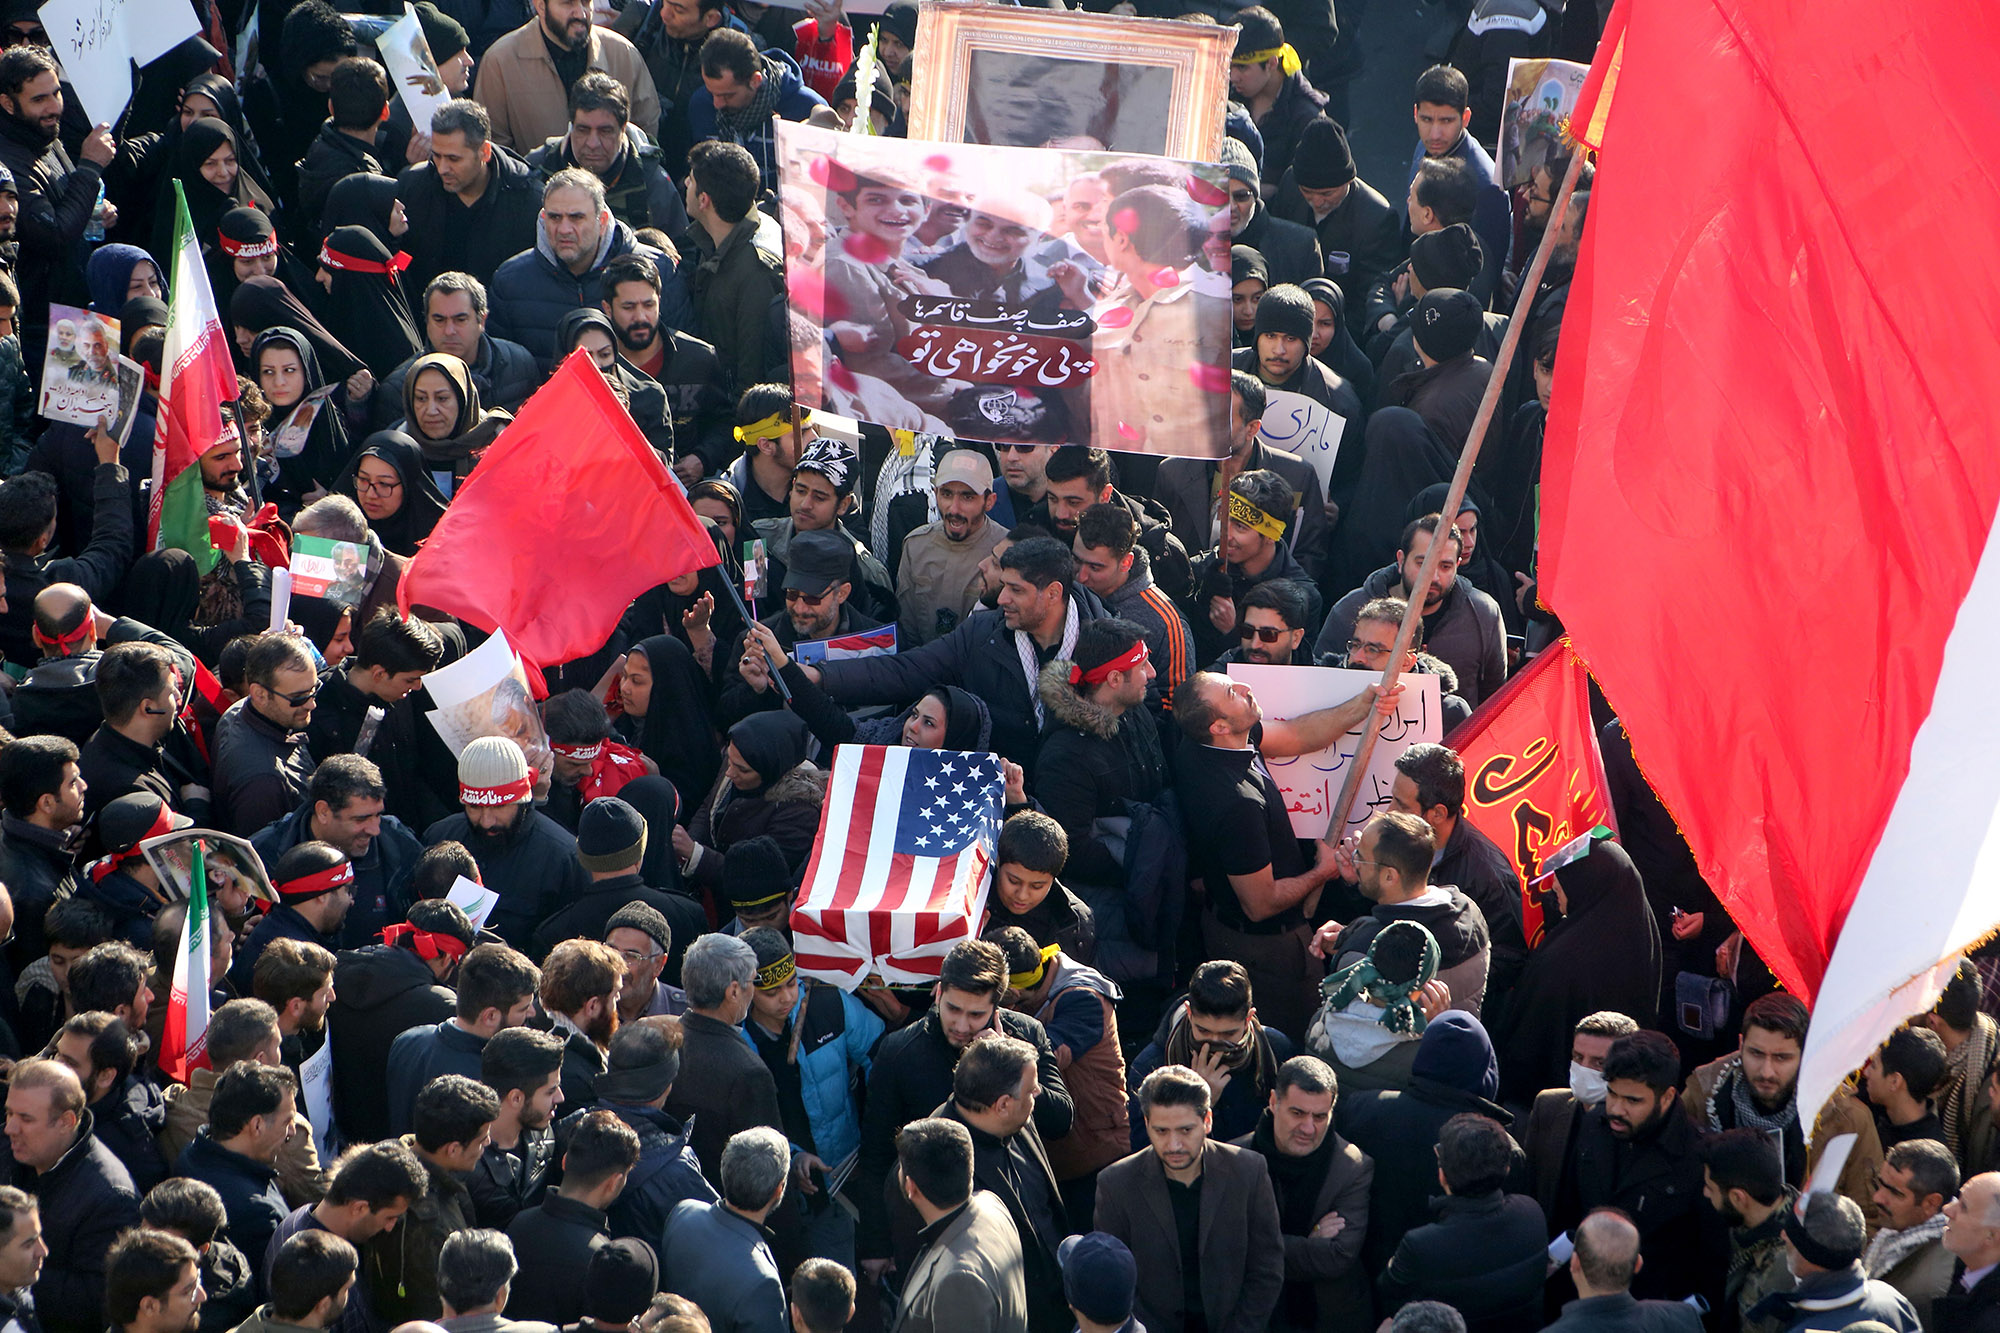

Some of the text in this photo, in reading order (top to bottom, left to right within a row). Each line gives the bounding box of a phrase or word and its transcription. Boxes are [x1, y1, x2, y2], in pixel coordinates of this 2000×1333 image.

[966, 306, 1029, 323] صف
[1027, 313, 1087, 330] صف
[909, 329, 1096, 386] پی خونخواهی تو
